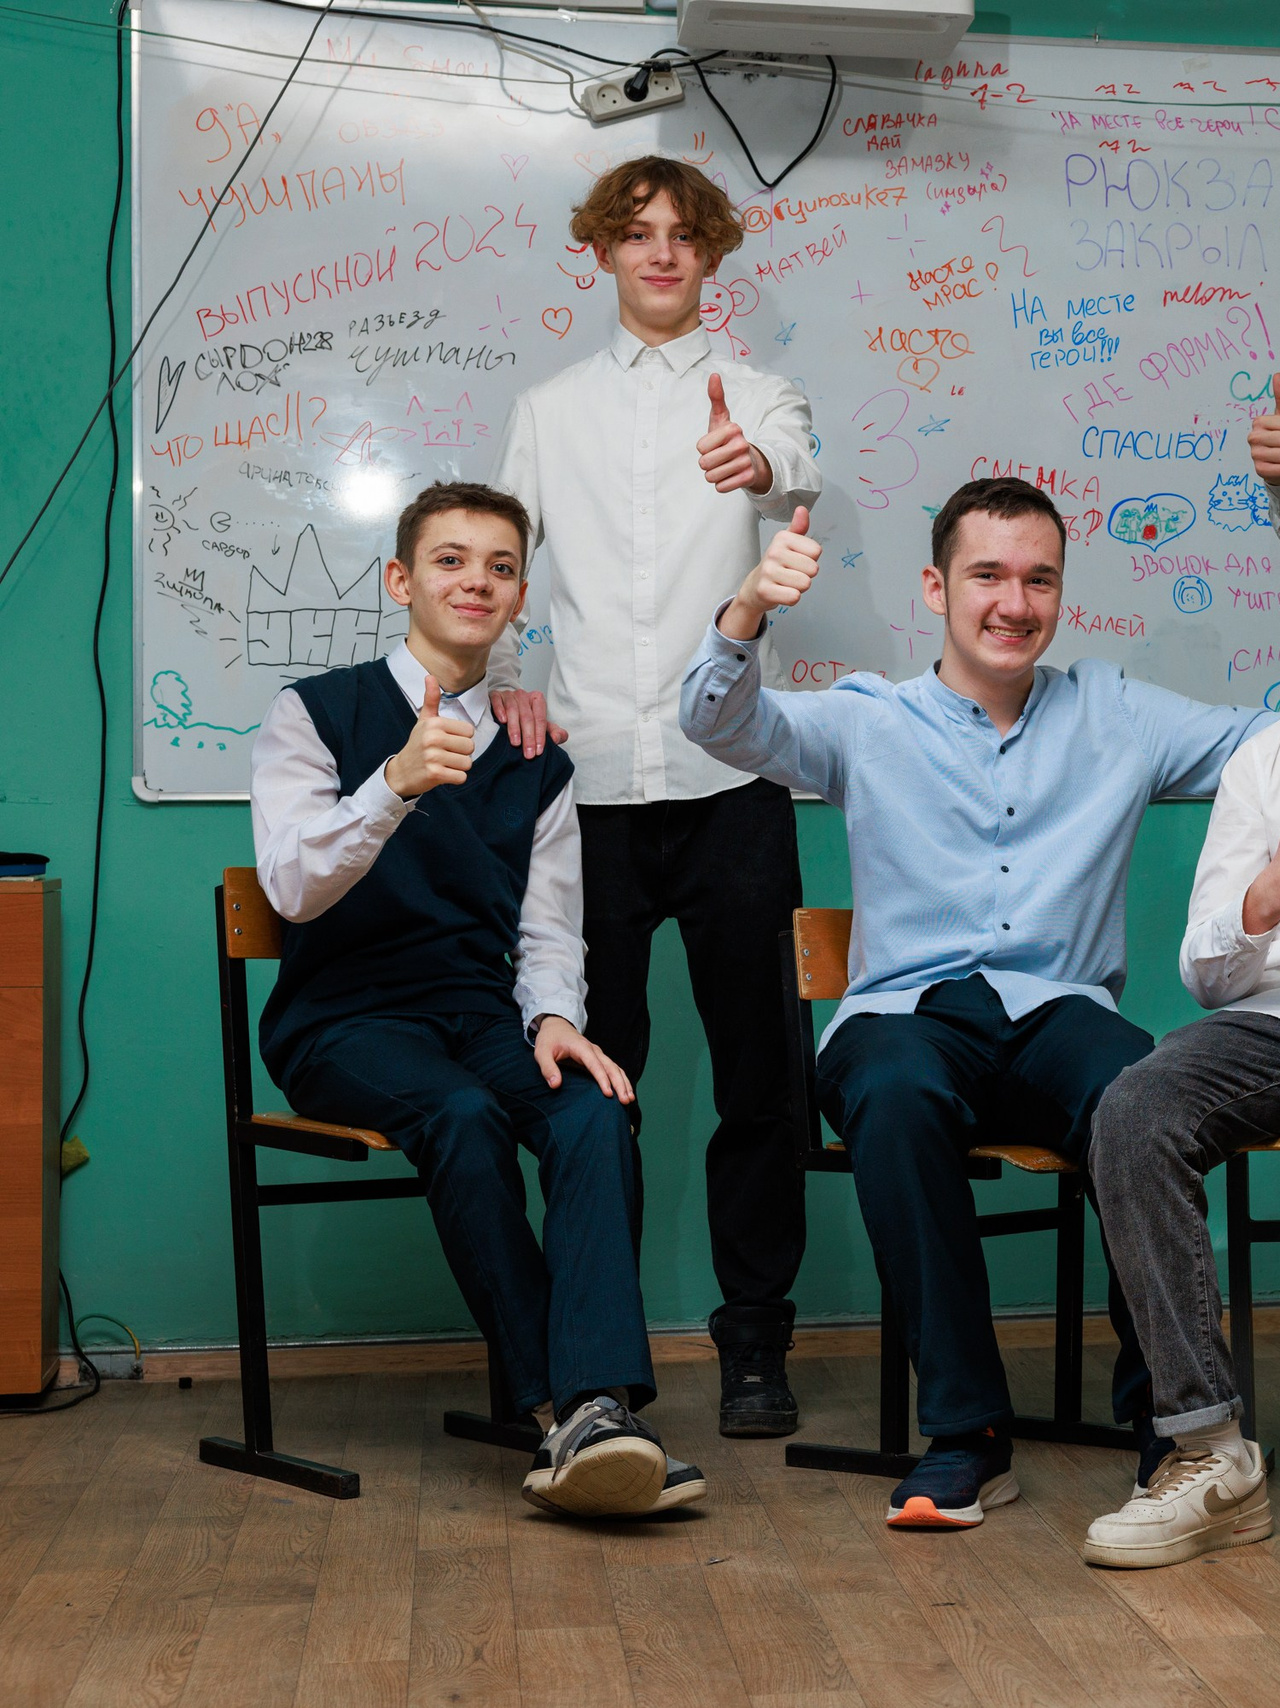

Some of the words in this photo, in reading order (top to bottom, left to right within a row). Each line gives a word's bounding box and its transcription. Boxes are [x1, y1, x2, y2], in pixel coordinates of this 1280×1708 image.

[1091, 114, 1143, 130] МЕСТЕ
[867, 134, 902, 152] ДАЙ
[885, 151, 971, 180] ЗАМАЗКУ
[195, 226, 399, 342] ВЫПУСКНОЙ
[413, 202, 538, 272] 2024
[1011, 287, 1048, 329] НА
[1062, 373, 1134, 424] ГДЕ
[150, 434, 204, 468] ЧТО
[1081, 425, 1228, 462] СПАСИБО!
[1130, 554, 1219, 582] ЗВОНОК
[1223, 552, 1272, 577] ДЛЯ
